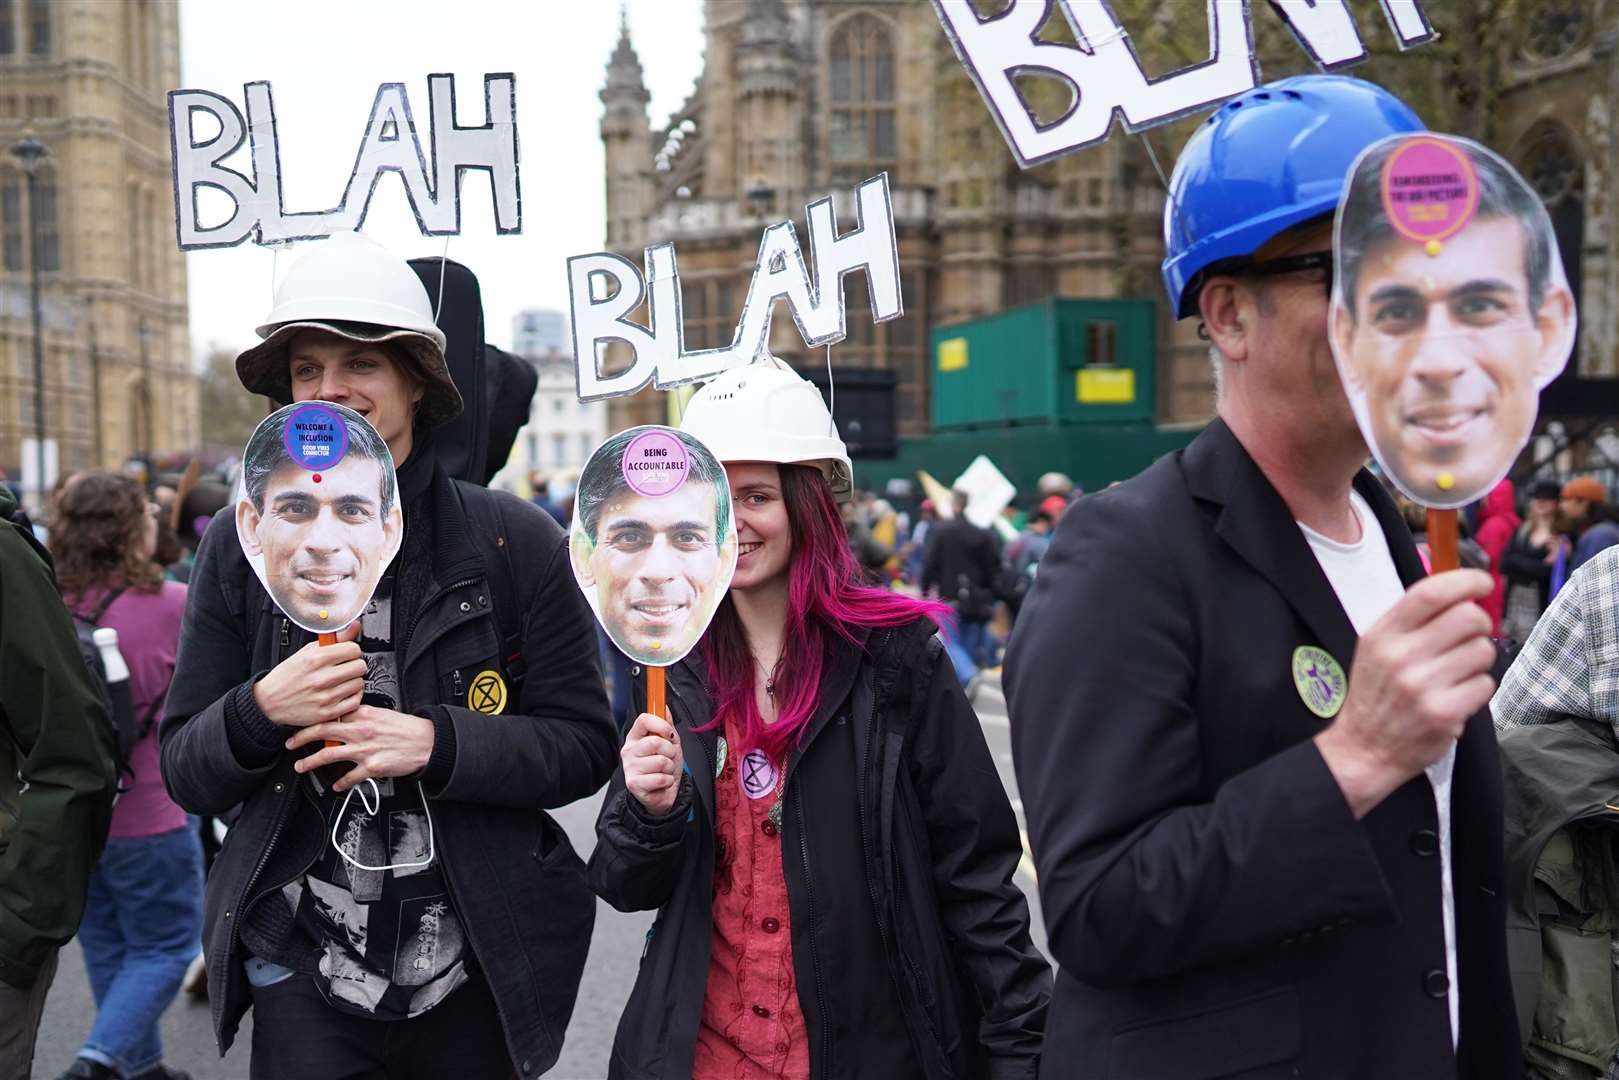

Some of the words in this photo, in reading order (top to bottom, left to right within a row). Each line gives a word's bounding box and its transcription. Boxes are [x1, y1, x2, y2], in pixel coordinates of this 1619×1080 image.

[168, 72, 523, 250] BLAH
[936, 0, 1441, 169] BL
[566, 171, 905, 403] BLAH
[628, 461, 684, 471] ACCOUNTABLE
[644, 448, 667, 457] BEING
